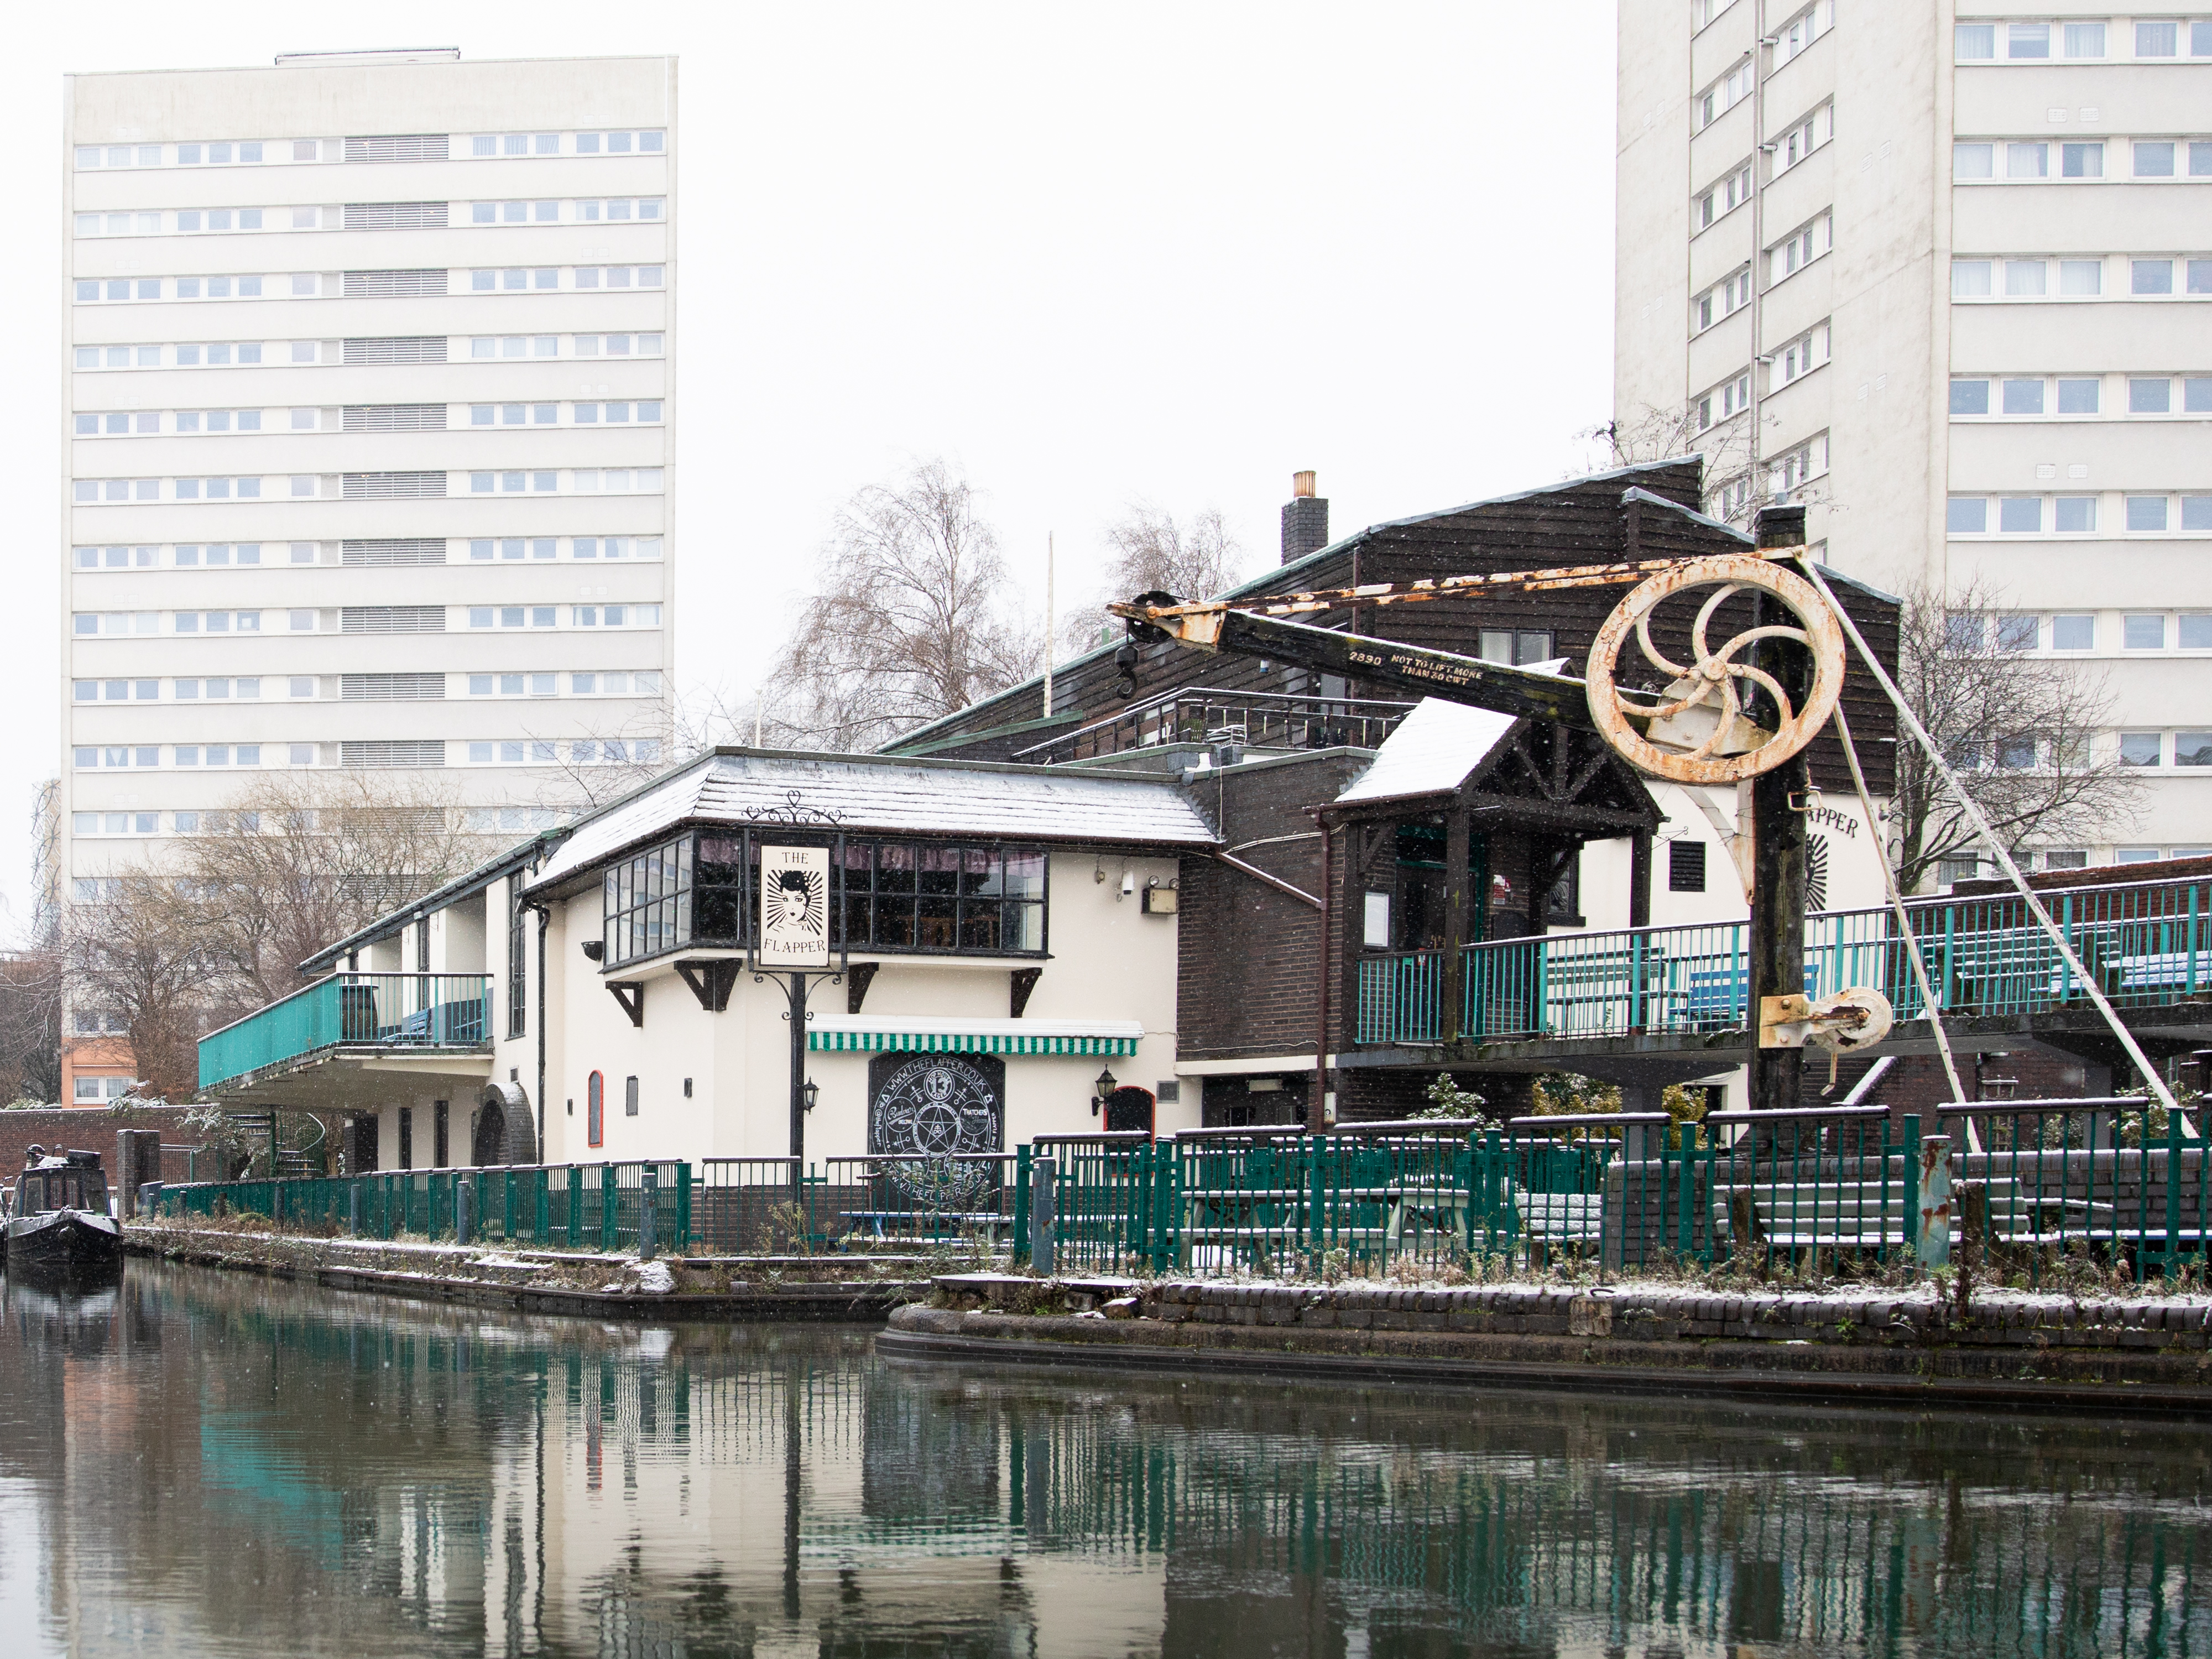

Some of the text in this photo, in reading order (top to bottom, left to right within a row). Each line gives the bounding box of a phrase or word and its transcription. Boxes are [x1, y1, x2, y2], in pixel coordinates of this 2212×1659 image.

[1349, 651, 1381, 665] 2890
[1391, 654, 1483, 680] NOT TO LIFT MORE
[1402, 665, 1469, 685] THAN 30 CWT
[782, 852, 808, 864] THE
[764, 938, 826, 953] FLAPPER
[886, 1057, 987, 1092] WWW.THEFLAPPER.CO.UK
[928, 1071, 951, 1085] HOP HOUSE
[931, 1076, 948, 1093] 13
[931, 1091, 947, 1099] LAGER
[962, 1108, 988, 1116] THATCHERS
[874, 1109, 883, 1147] @theflapper
